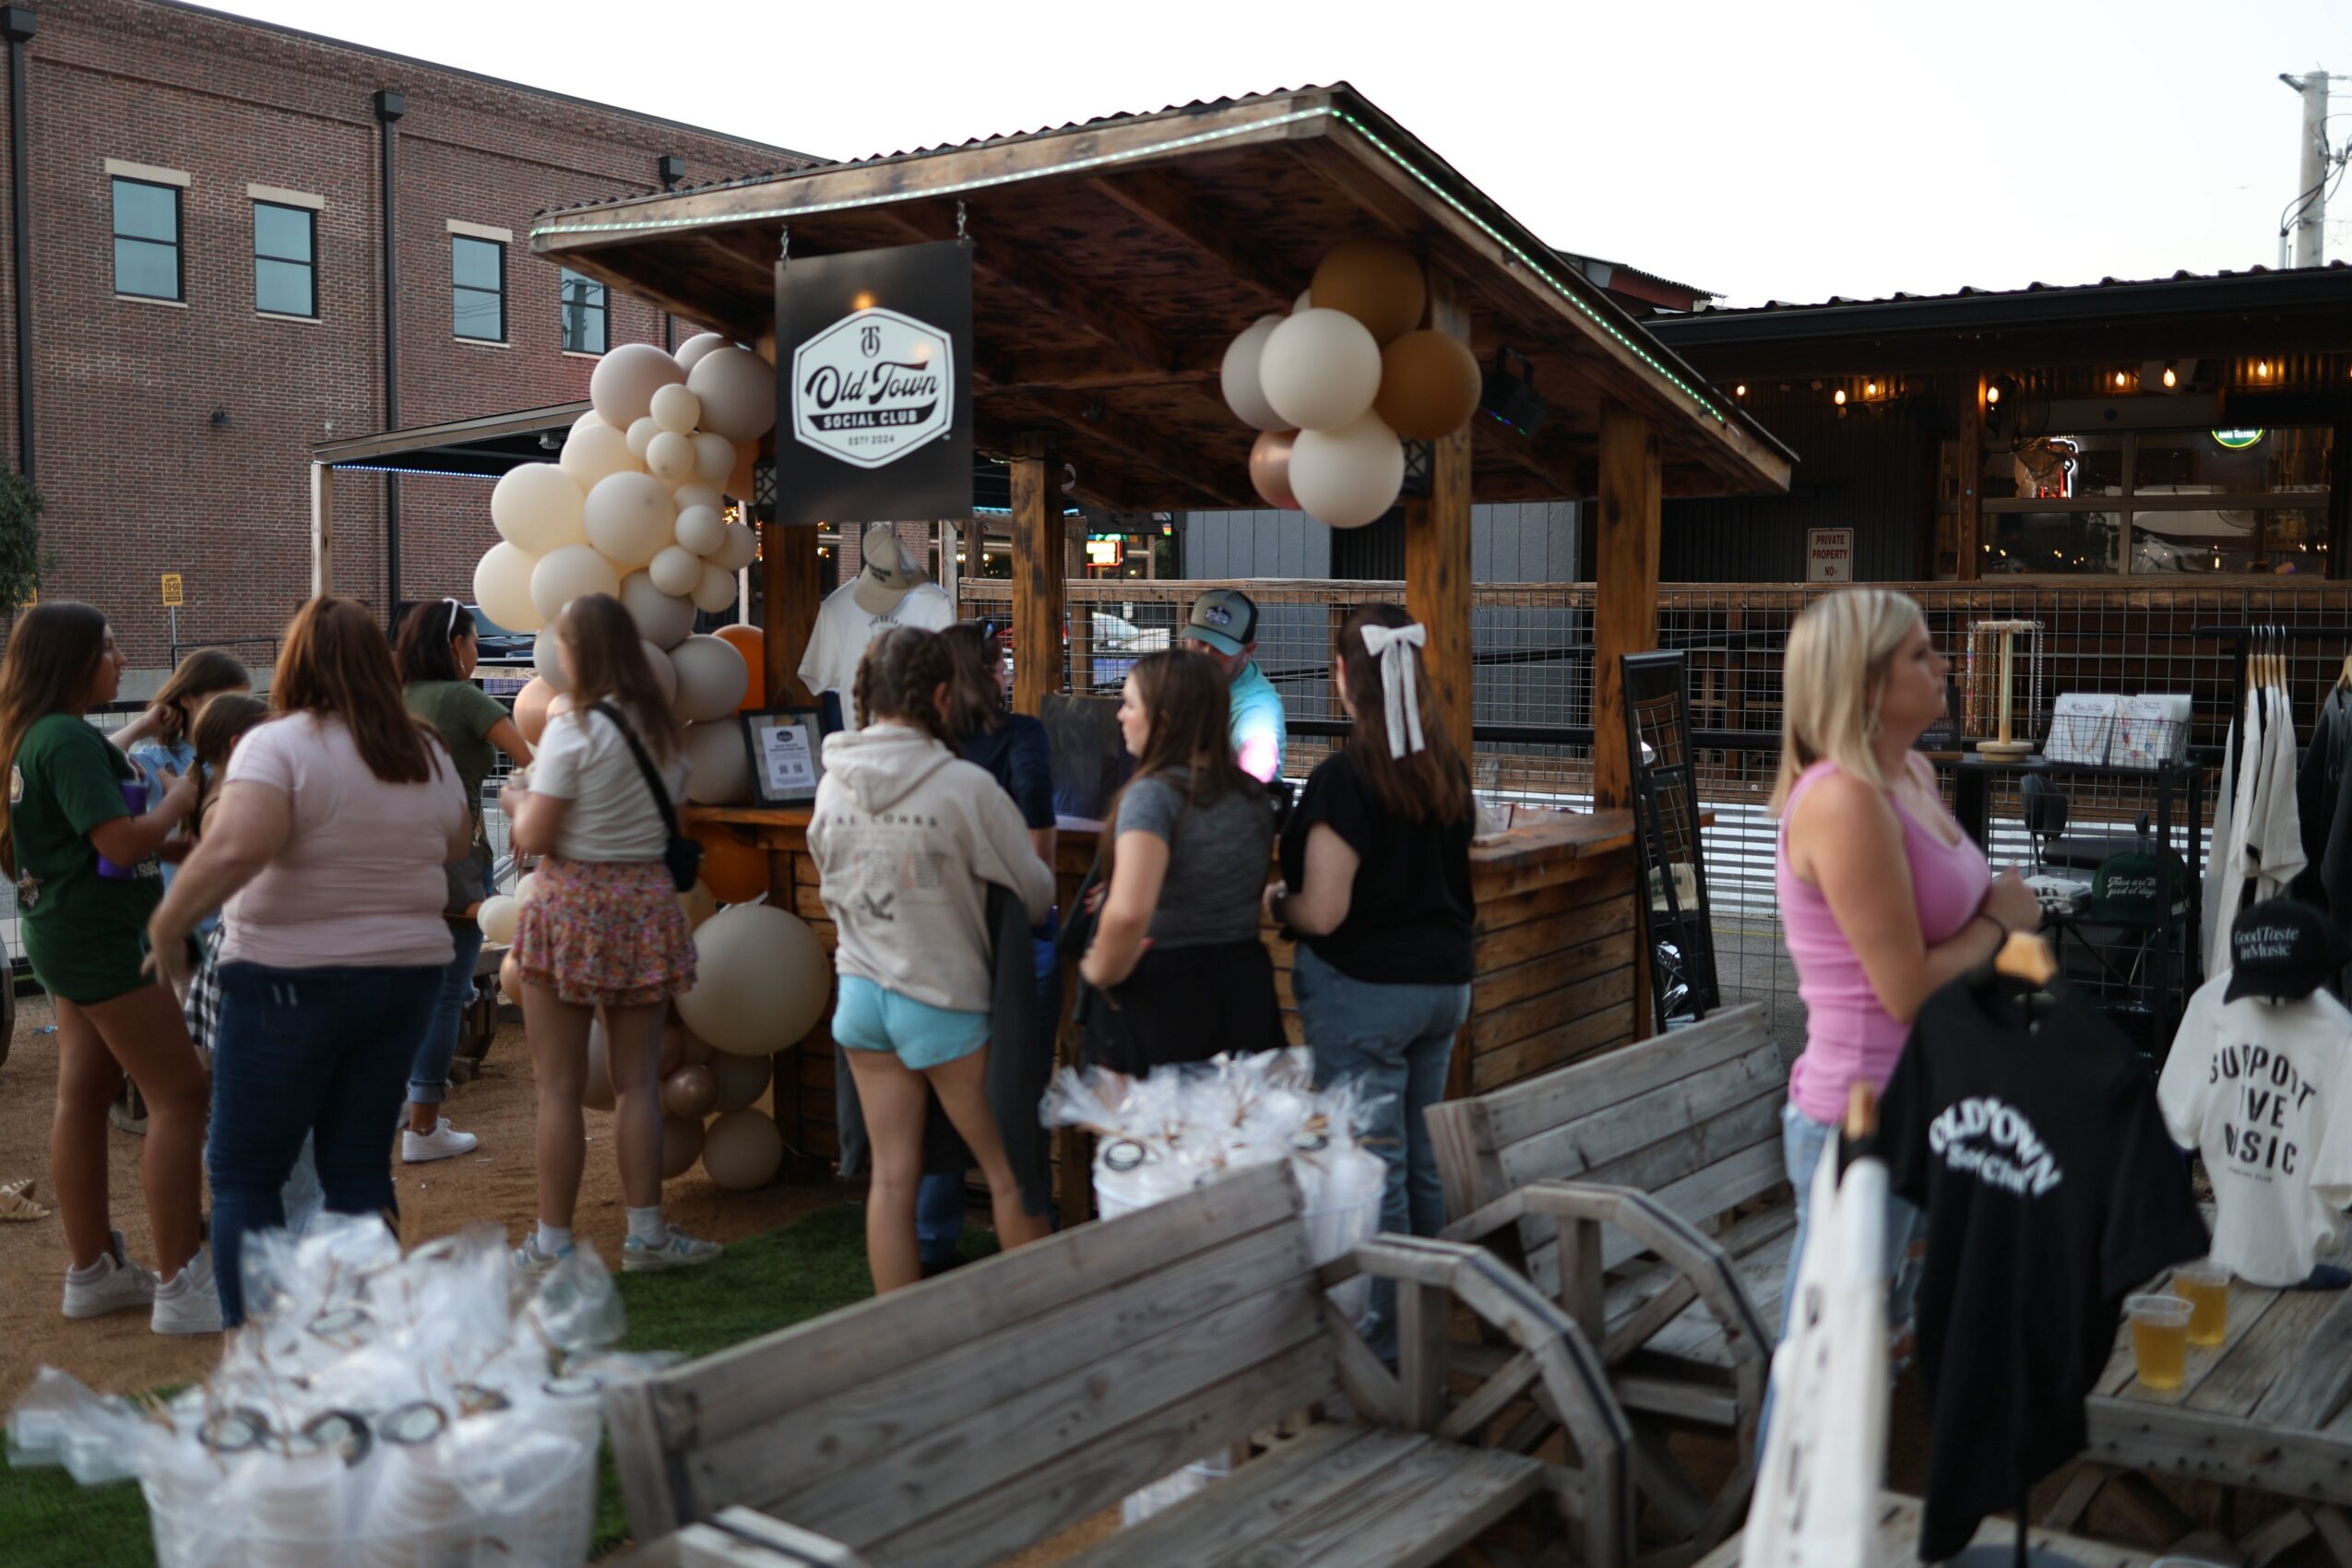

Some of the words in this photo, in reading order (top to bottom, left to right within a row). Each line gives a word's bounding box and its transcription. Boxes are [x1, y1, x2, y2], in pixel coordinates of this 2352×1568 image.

[804, 365, 868, 410] Old
[868, 360, 940, 406] Town
[824, 415, 874, 430] SOCIAL
[880, 410, 919, 424] CLUB
[872, 434, 895, 445] 2024
[1816, 534, 1846, 545] PRIVATE
[1812, 549, 1848, 560] PROPERTY
[1824, 565, 1835, 576] NO
[2108, 876, 2131, 888] These
[2106, 886, 2129, 899] good
[1929, 1097, 1989, 1154] OLD
